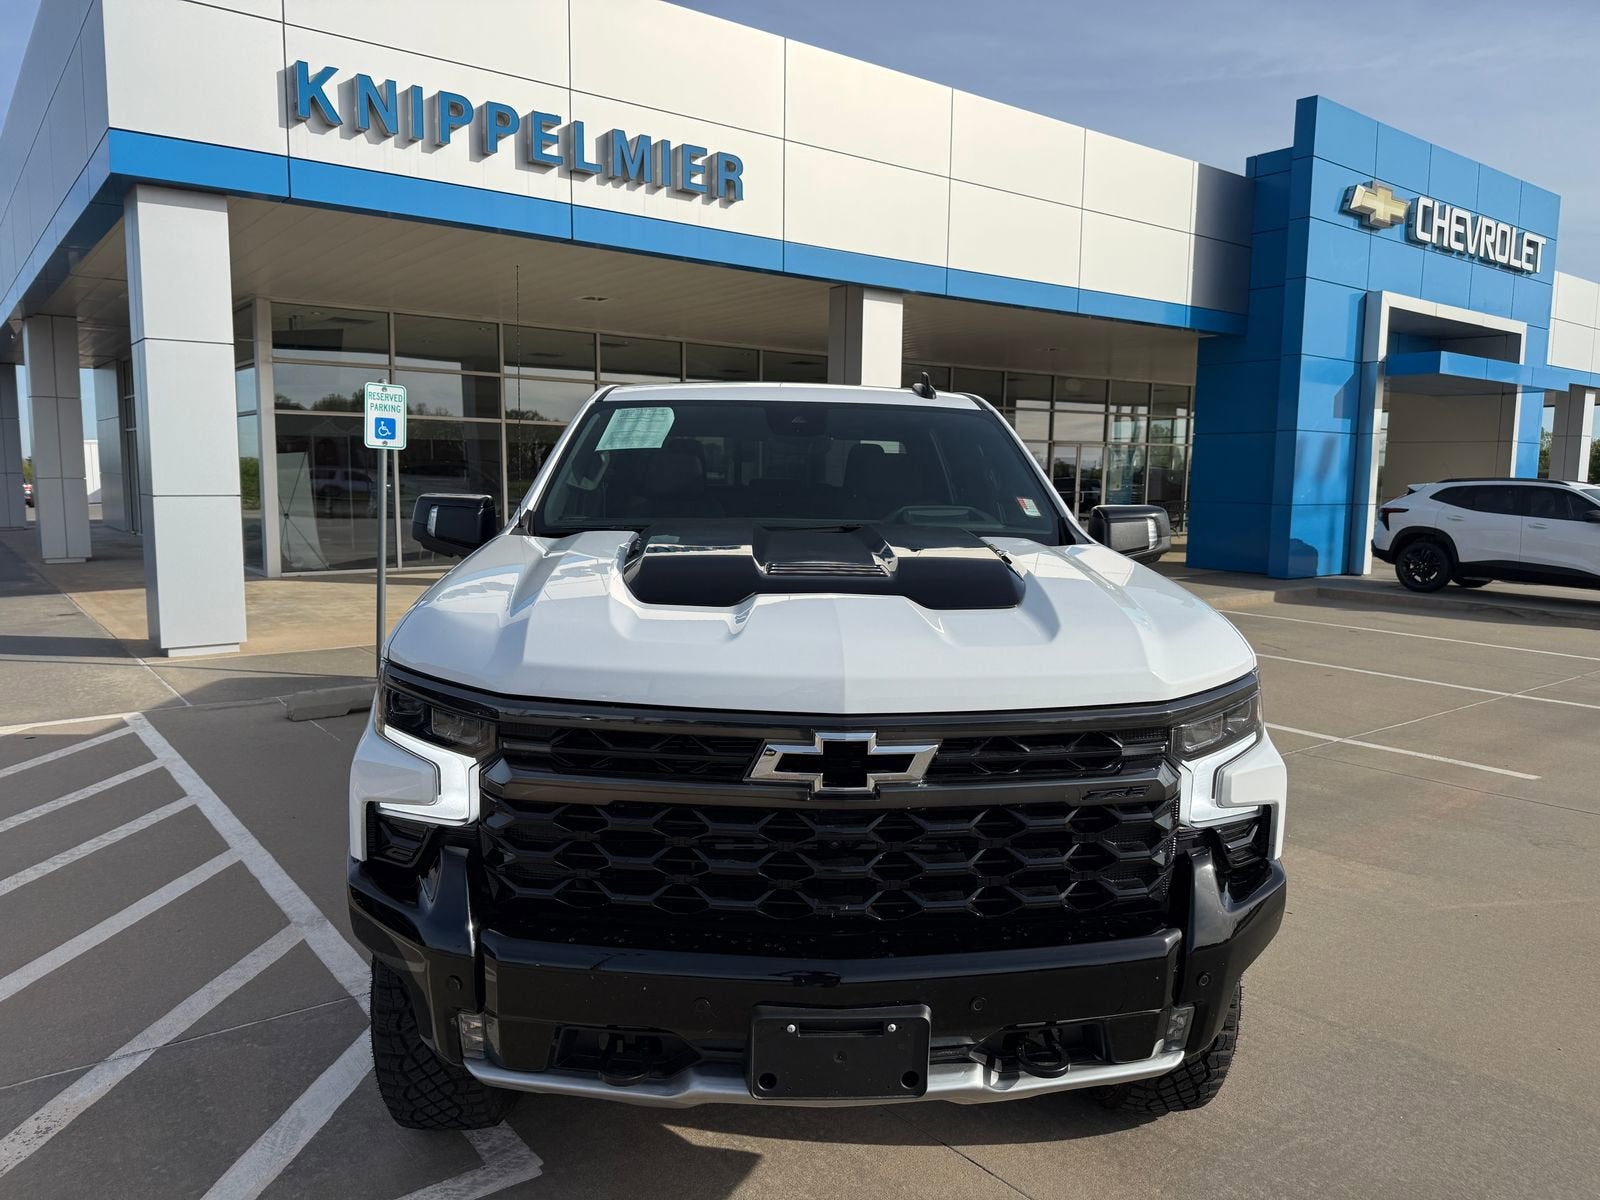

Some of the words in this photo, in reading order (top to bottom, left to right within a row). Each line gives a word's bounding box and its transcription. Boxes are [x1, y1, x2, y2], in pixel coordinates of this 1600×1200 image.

[294, 60, 745, 201] KNIPPELMIER
[1414, 195, 1547, 273] CHEVROLET
[368, 391, 403, 403] RESERVED
[369, 402, 401, 414] PARKING
